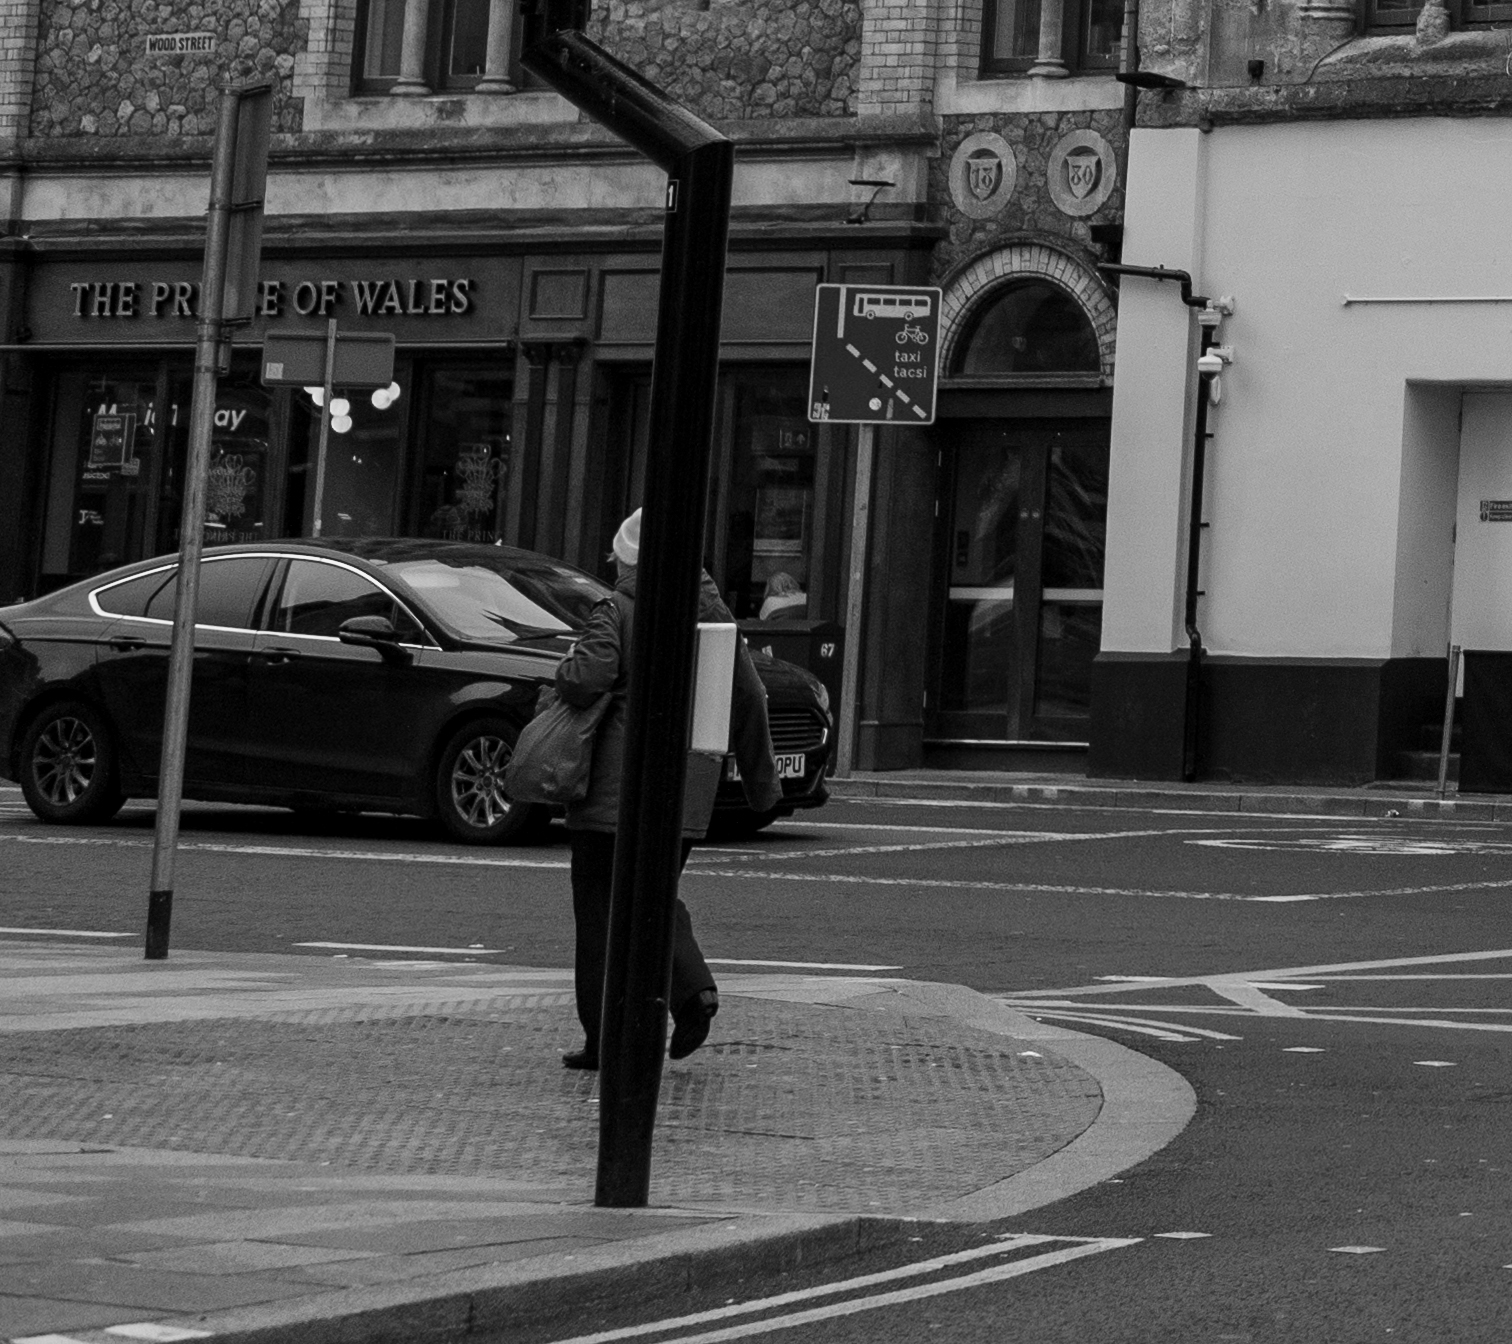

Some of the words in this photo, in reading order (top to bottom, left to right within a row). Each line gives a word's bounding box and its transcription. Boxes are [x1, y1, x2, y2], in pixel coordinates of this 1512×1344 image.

[149, 37, 177, 51] WOOD
[179, 36, 213, 51] STREET
[70, 283, 135, 316] THE
[150, 281, 280, 316] PRE
[293, 281, 338, 314] OF
[351, 279, 470, 314] WALES
[895, 350, 920, 362] taxi
[894, 366, 927, 378] tacsi
[821, 643, 835, 657] 67
